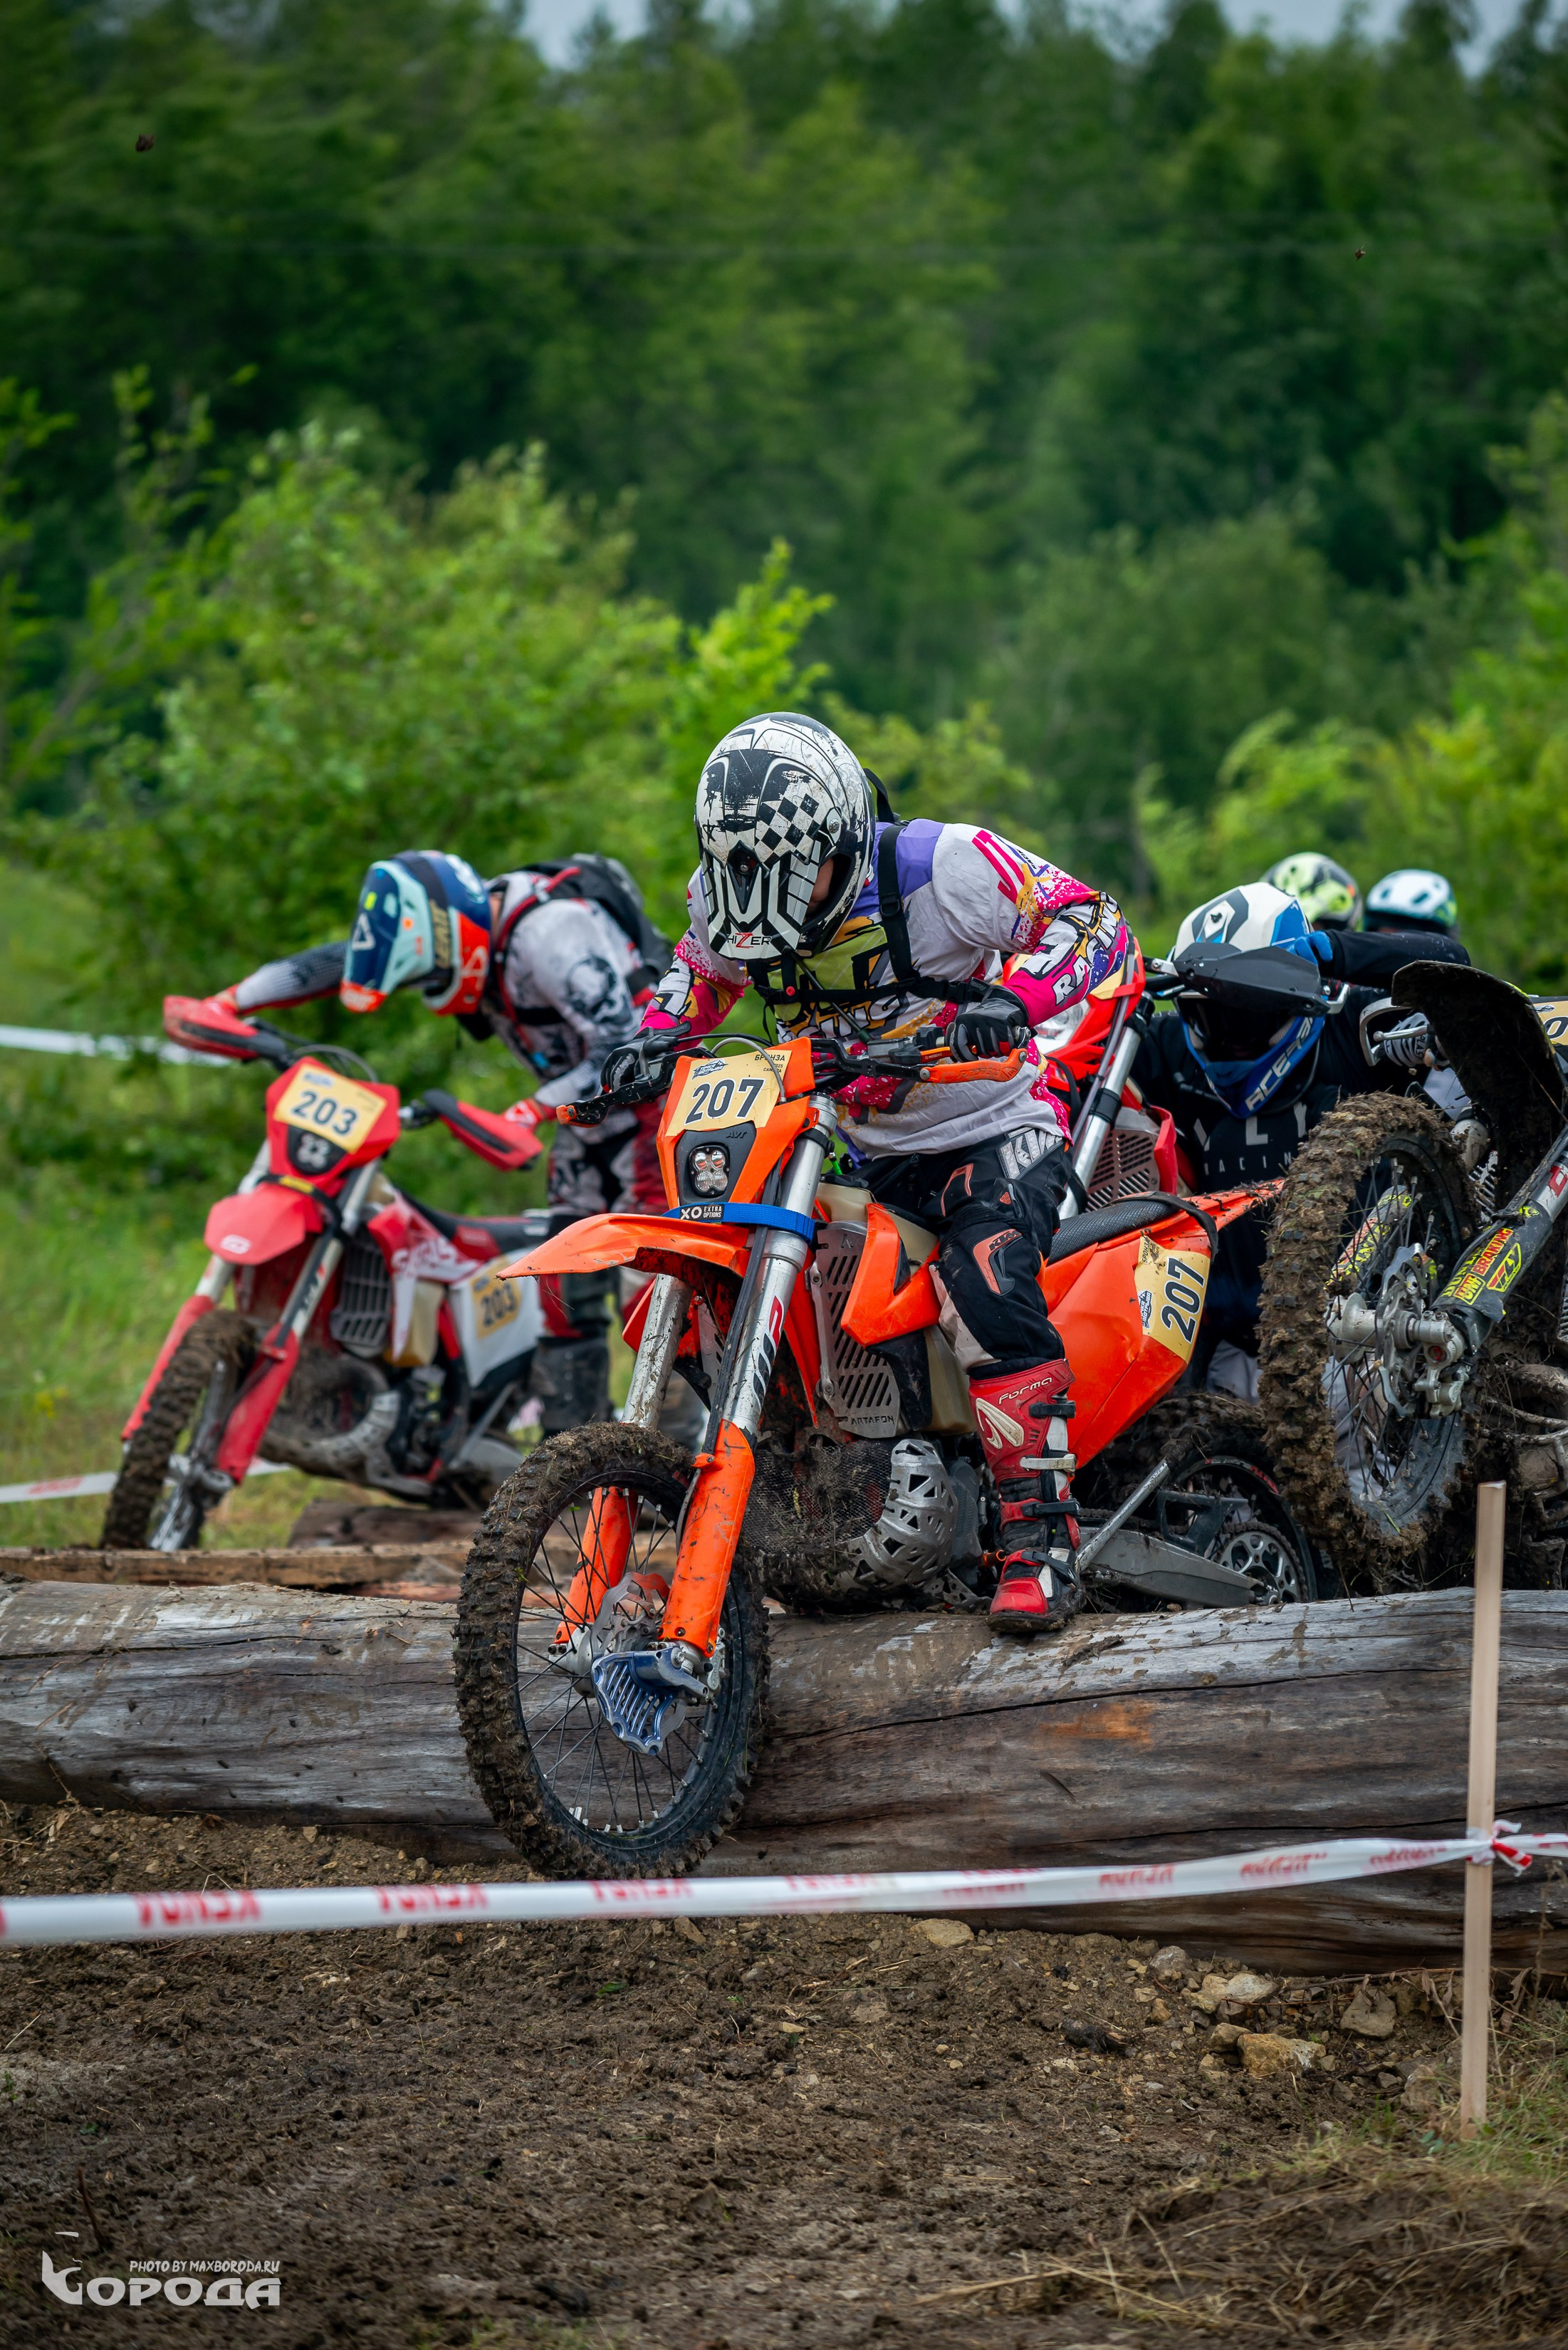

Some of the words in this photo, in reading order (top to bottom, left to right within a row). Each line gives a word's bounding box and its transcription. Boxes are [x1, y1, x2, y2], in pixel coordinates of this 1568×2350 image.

[726, 931, 773, 949] HIZER
[292, 1090, 358, 1136] 203
[684, 1078, 765, 1126] 207
[680, 1206, 702, 1220] XO
[1470, 1227, 1515, 1277] BRAKING
[1161, 1257, 1205, 1344] 207
[851, 1415, 895, 1425] ARTAFON
